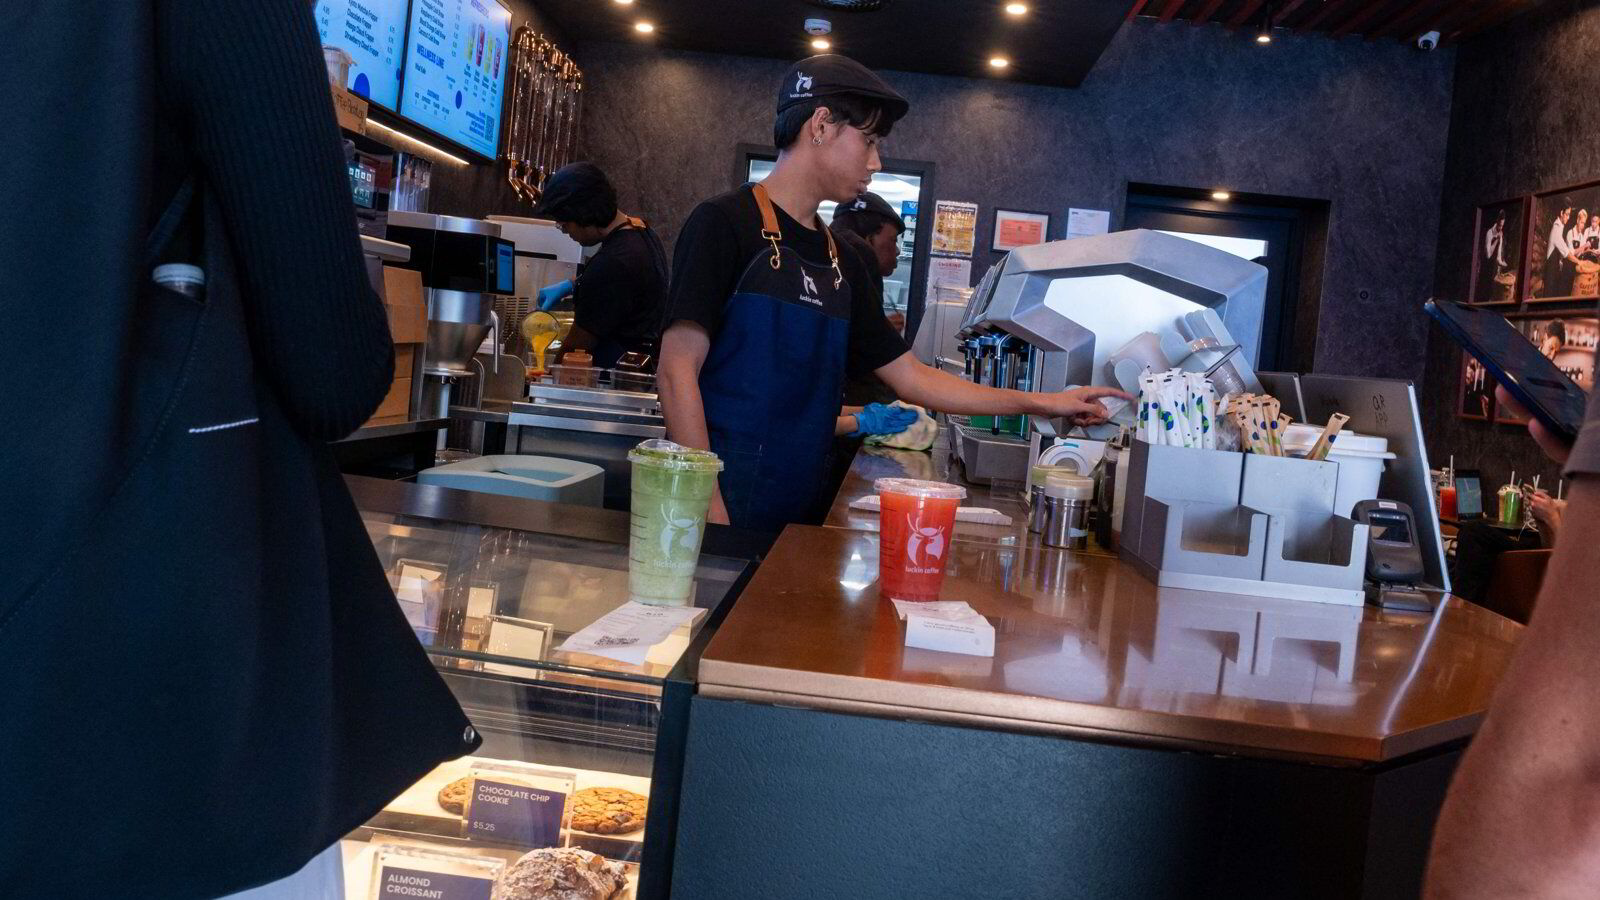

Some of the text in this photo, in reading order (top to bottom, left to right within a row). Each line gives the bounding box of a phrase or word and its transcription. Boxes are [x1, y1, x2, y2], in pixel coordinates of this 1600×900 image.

[416, 43, 445, 69] WELLNESS LINE
[905, 565, 940, 574] luckin coffee
[478, 793, 509, 805] COOKIE
[479, 785, 550, 802] CHOCOLATE CHIP
[473, 821, 495, 831] $5.25
[388, 874, 431, 887] ALMOND
[386, 884, 443, 899] CROISSANT
